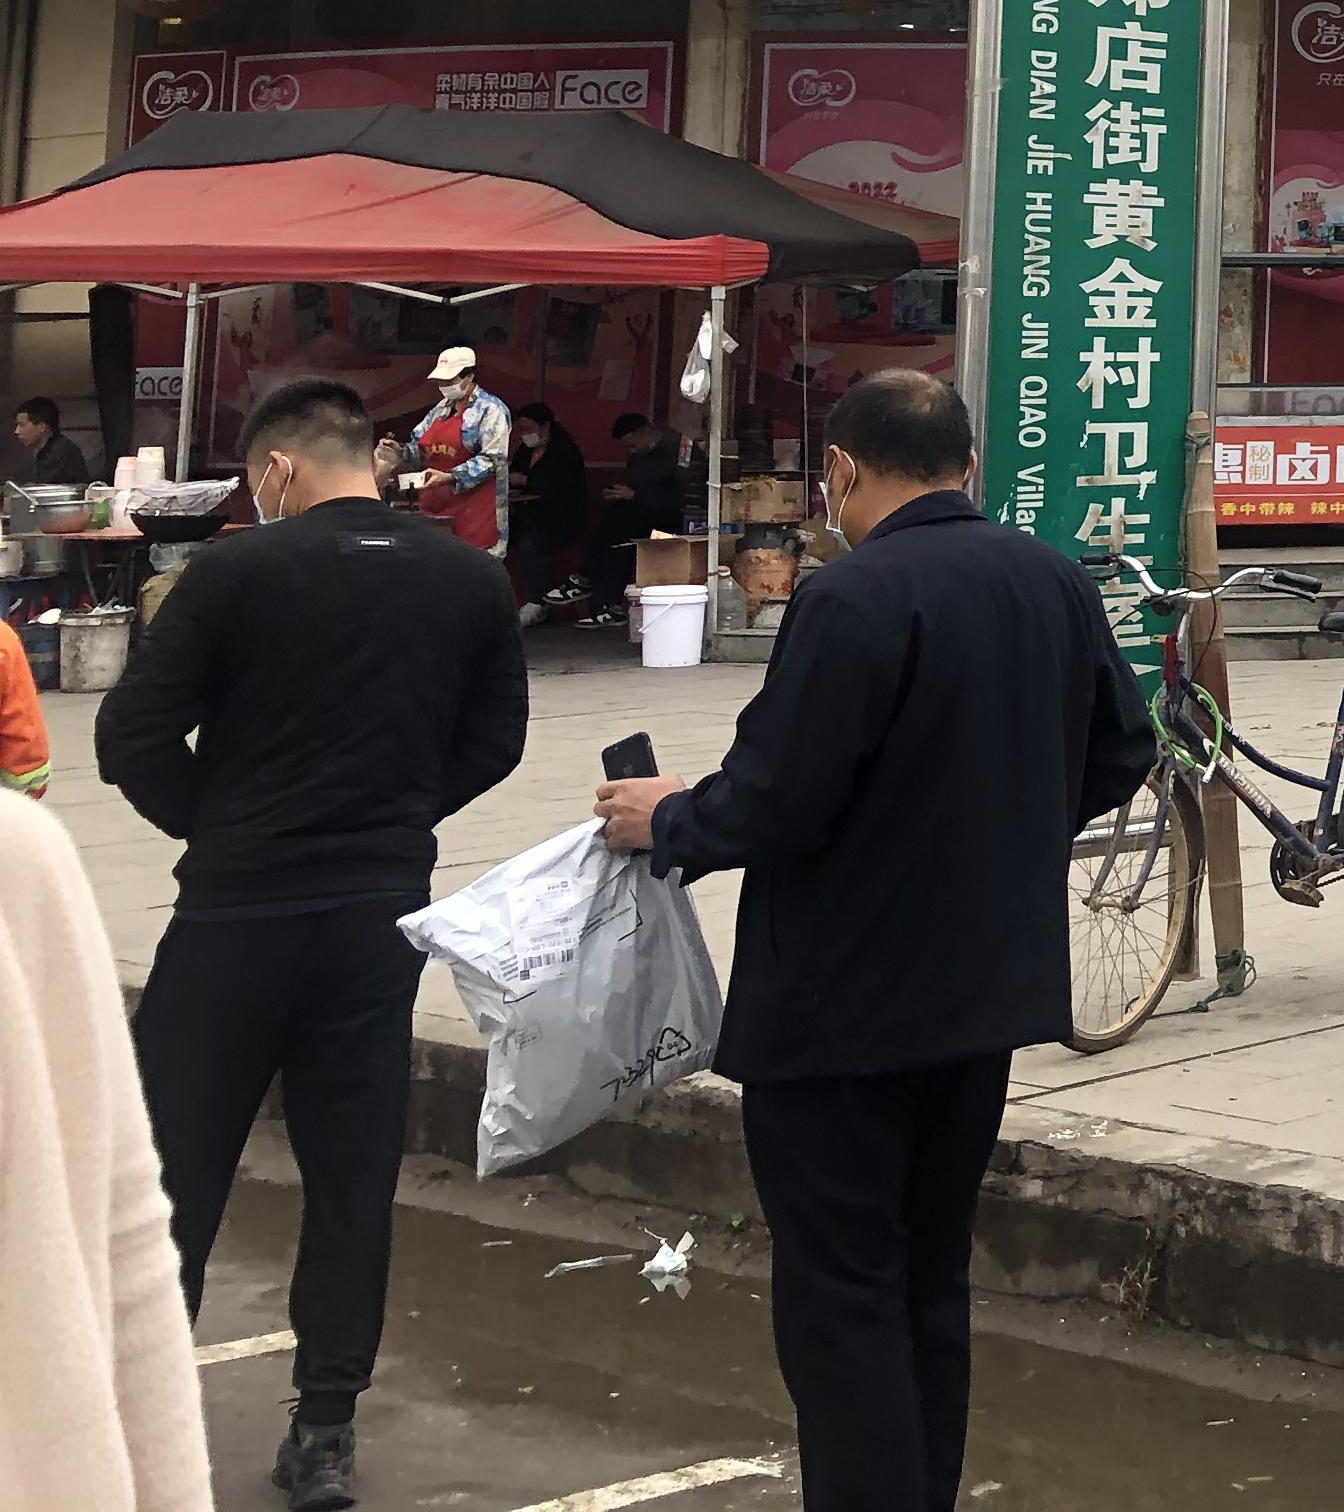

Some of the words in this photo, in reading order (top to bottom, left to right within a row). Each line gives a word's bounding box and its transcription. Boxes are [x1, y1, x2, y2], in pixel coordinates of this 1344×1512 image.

[560, 74, 643, 106] Face
[1028, 50, 1058, 120] DIAN
[1021, 191, 1053, 297] HUANG
[1019, 312, 1050, 359] JIN
[1016, 375, 1048, 448] QIAO
